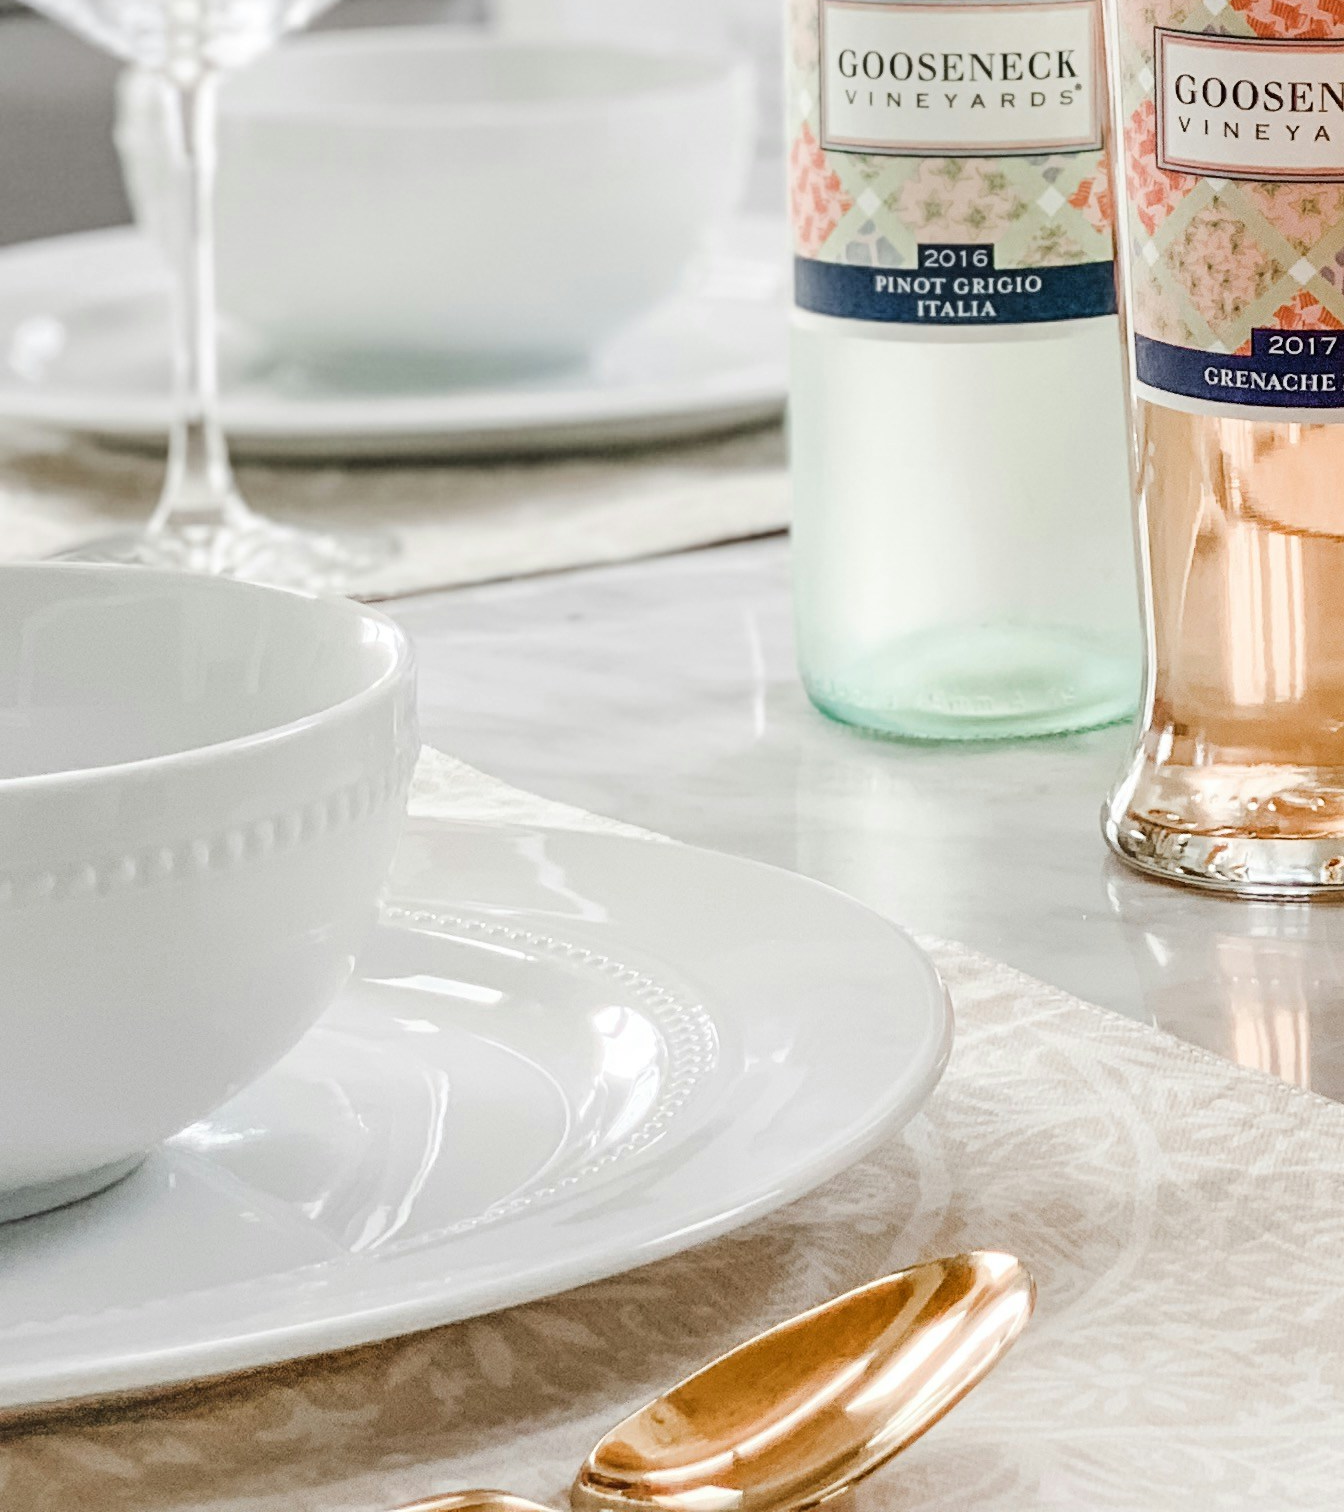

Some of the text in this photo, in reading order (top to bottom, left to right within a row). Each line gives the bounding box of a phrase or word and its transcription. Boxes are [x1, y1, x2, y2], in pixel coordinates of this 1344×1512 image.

[838, 48, 1078, 83] GOOSENECK
[923, 249, 989, 268] 2016
[874, 275, 1043, 296] PINOT GRIGIO
[917, 300, 998, 318] ITALIA
[1268, 335, 1338, 356] 2017
[1203, 366, 1336, 392] GRENACHE
